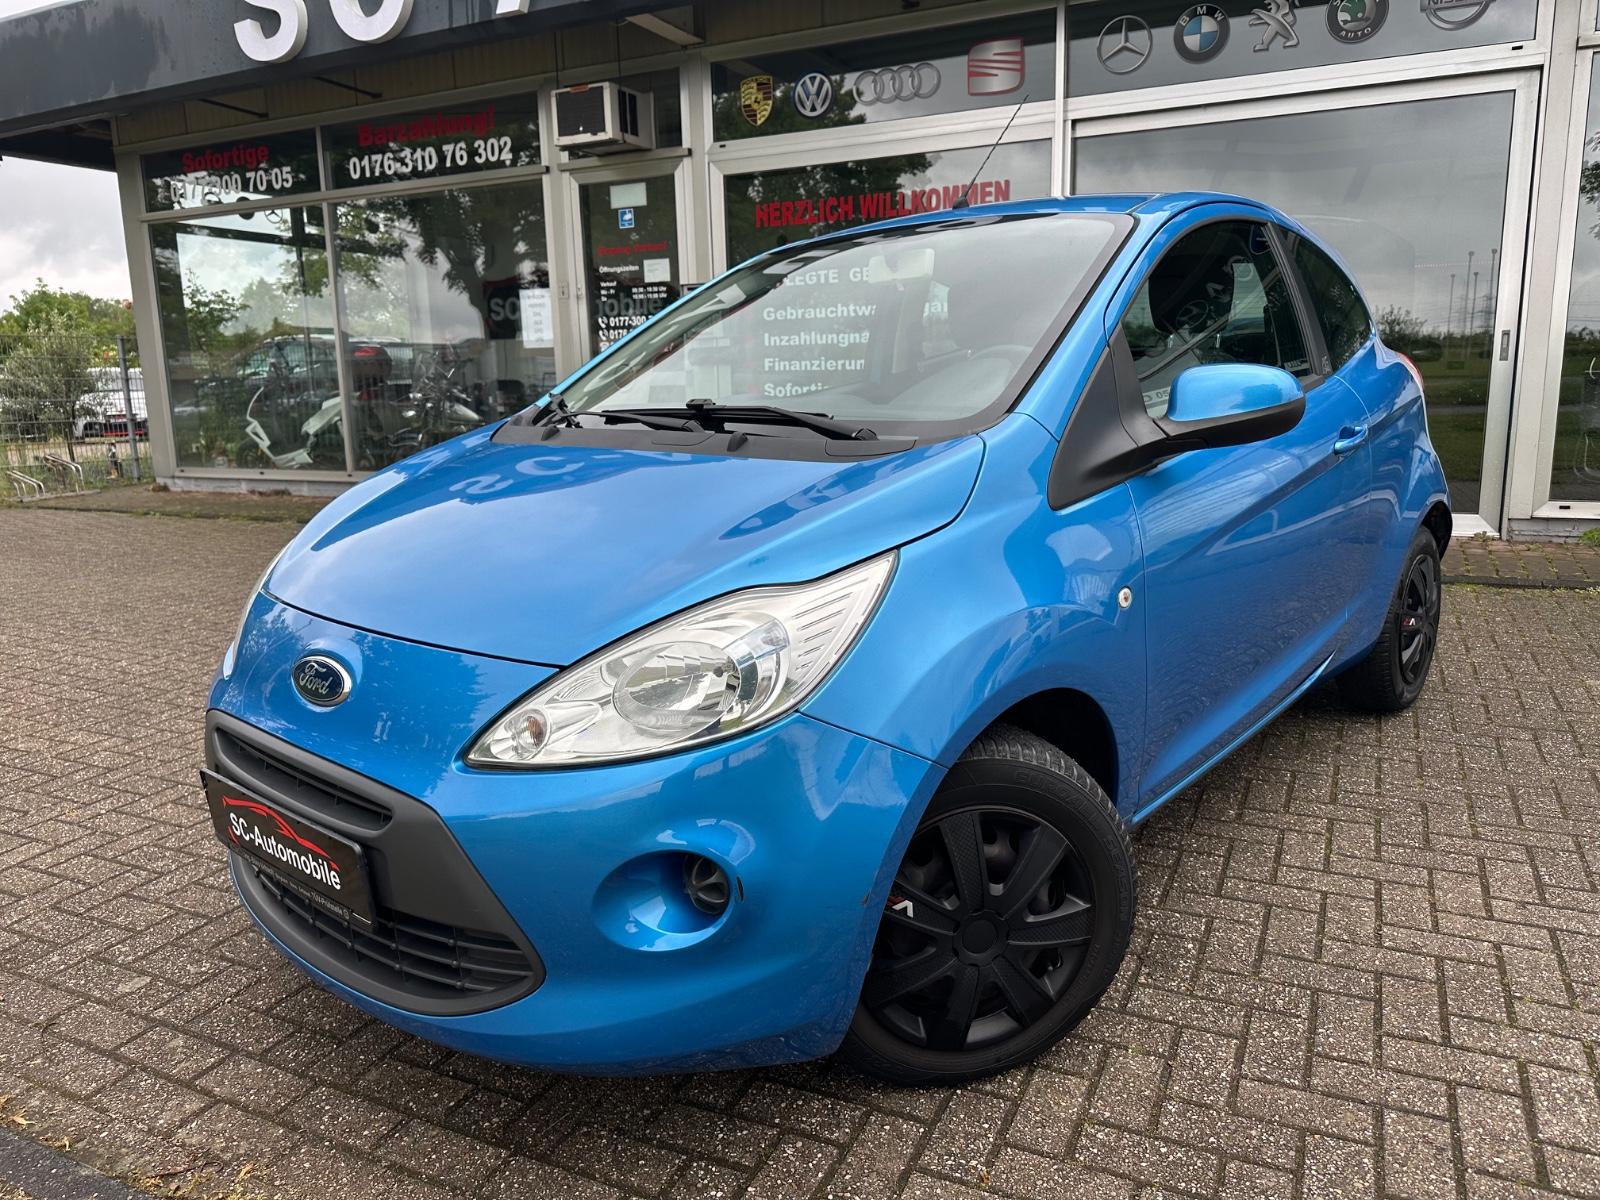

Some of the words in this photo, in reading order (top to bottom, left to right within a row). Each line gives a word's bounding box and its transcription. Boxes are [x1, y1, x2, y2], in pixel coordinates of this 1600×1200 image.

[1179, 6, 1225, 27] BMW
[1339, 27, 1372, 38] AUTO
[358, 104, 495, 147] Barzahlung!
[182, 145, 269, 173] Sofortige
[349, 147, 437, 180] 0176-310
[442, 142, 468, 168] 76
[473, 136, 513, 164] 302
[246, 170, 267, 192] 70
[271, 166, 293, 190] 05
[755, 192, 853, 228] HERZLICH
[860, 179, 1011, 218] WILLKOMMEN
[764, 330, 870, 347] Inzahlungna
[764, 357, 865, 373] Finanzierun
[299, 662, 334, 694] Ford
[229, 812, 341, 891] SC-Automobile
